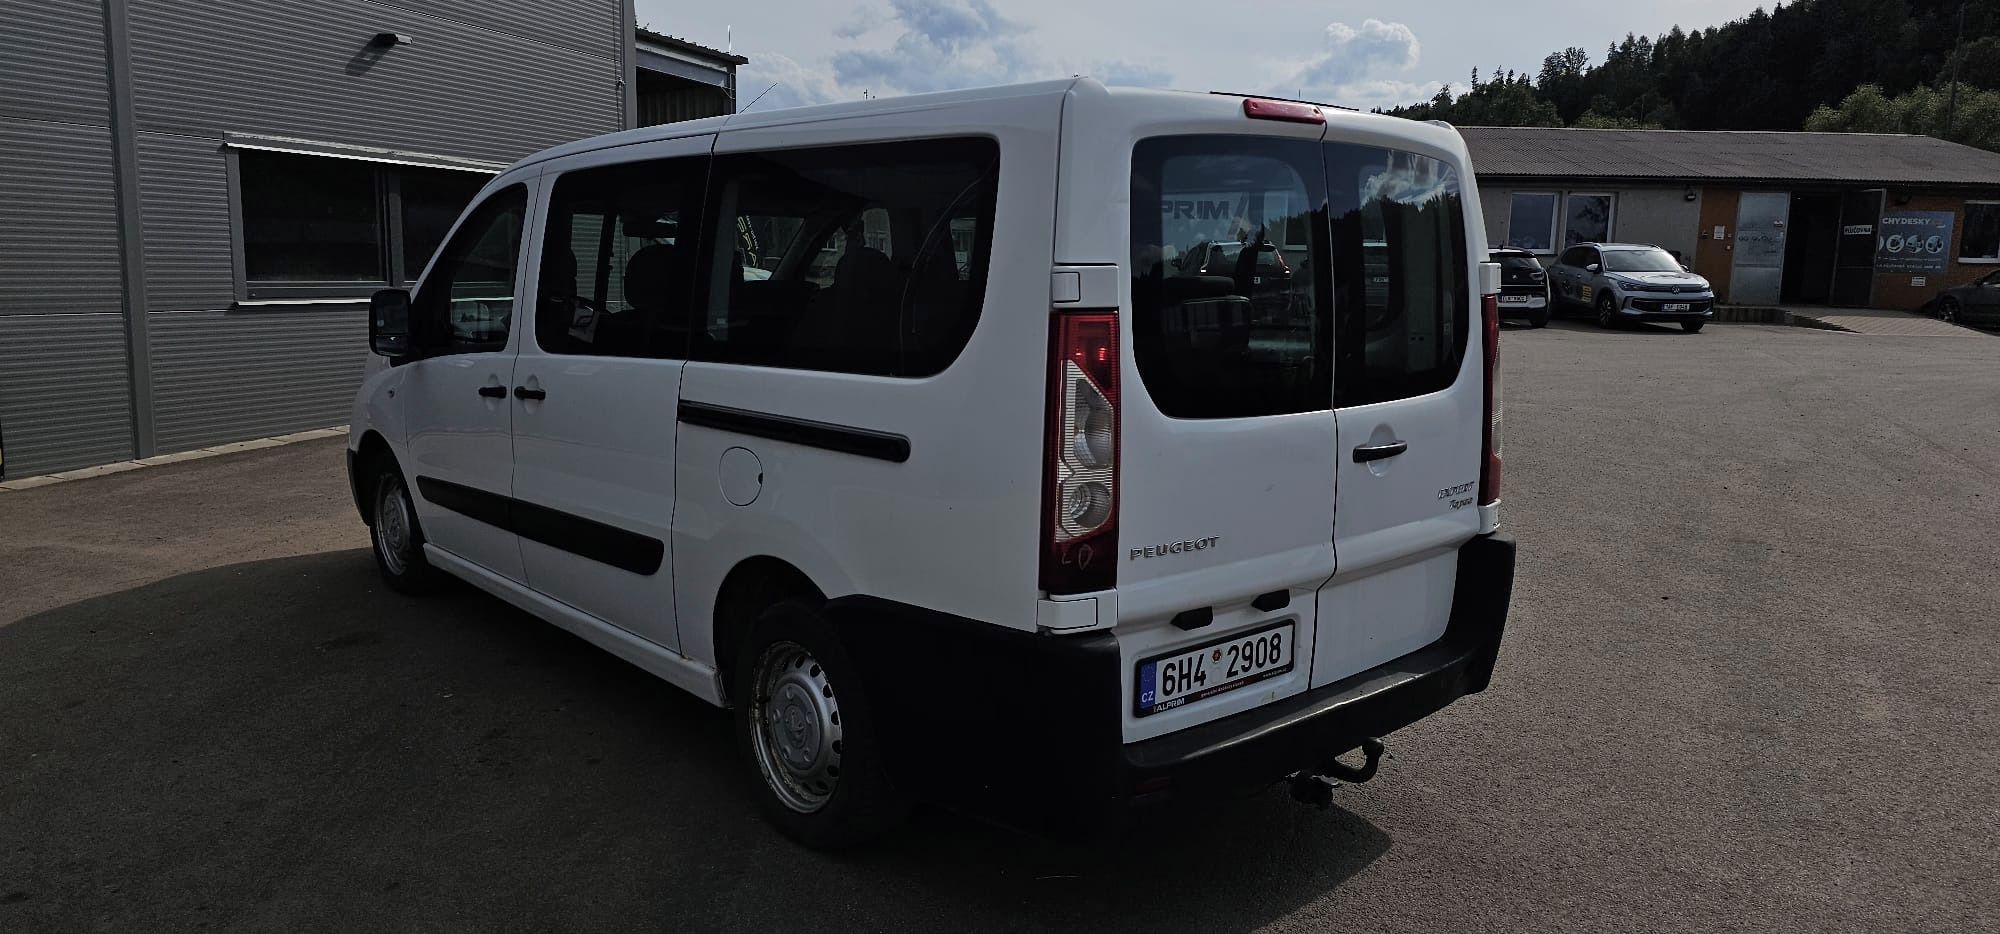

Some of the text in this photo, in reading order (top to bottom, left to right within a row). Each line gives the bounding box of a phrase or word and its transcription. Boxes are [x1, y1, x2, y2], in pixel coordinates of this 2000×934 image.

[1130, 535, 1220, 561] PEUGEOT
[1162, 632, 1282, 697] 6H4 2908
[1140, 689, 1154, 704] CZ
[1156, 697, 1185, 712] ALPRIM
